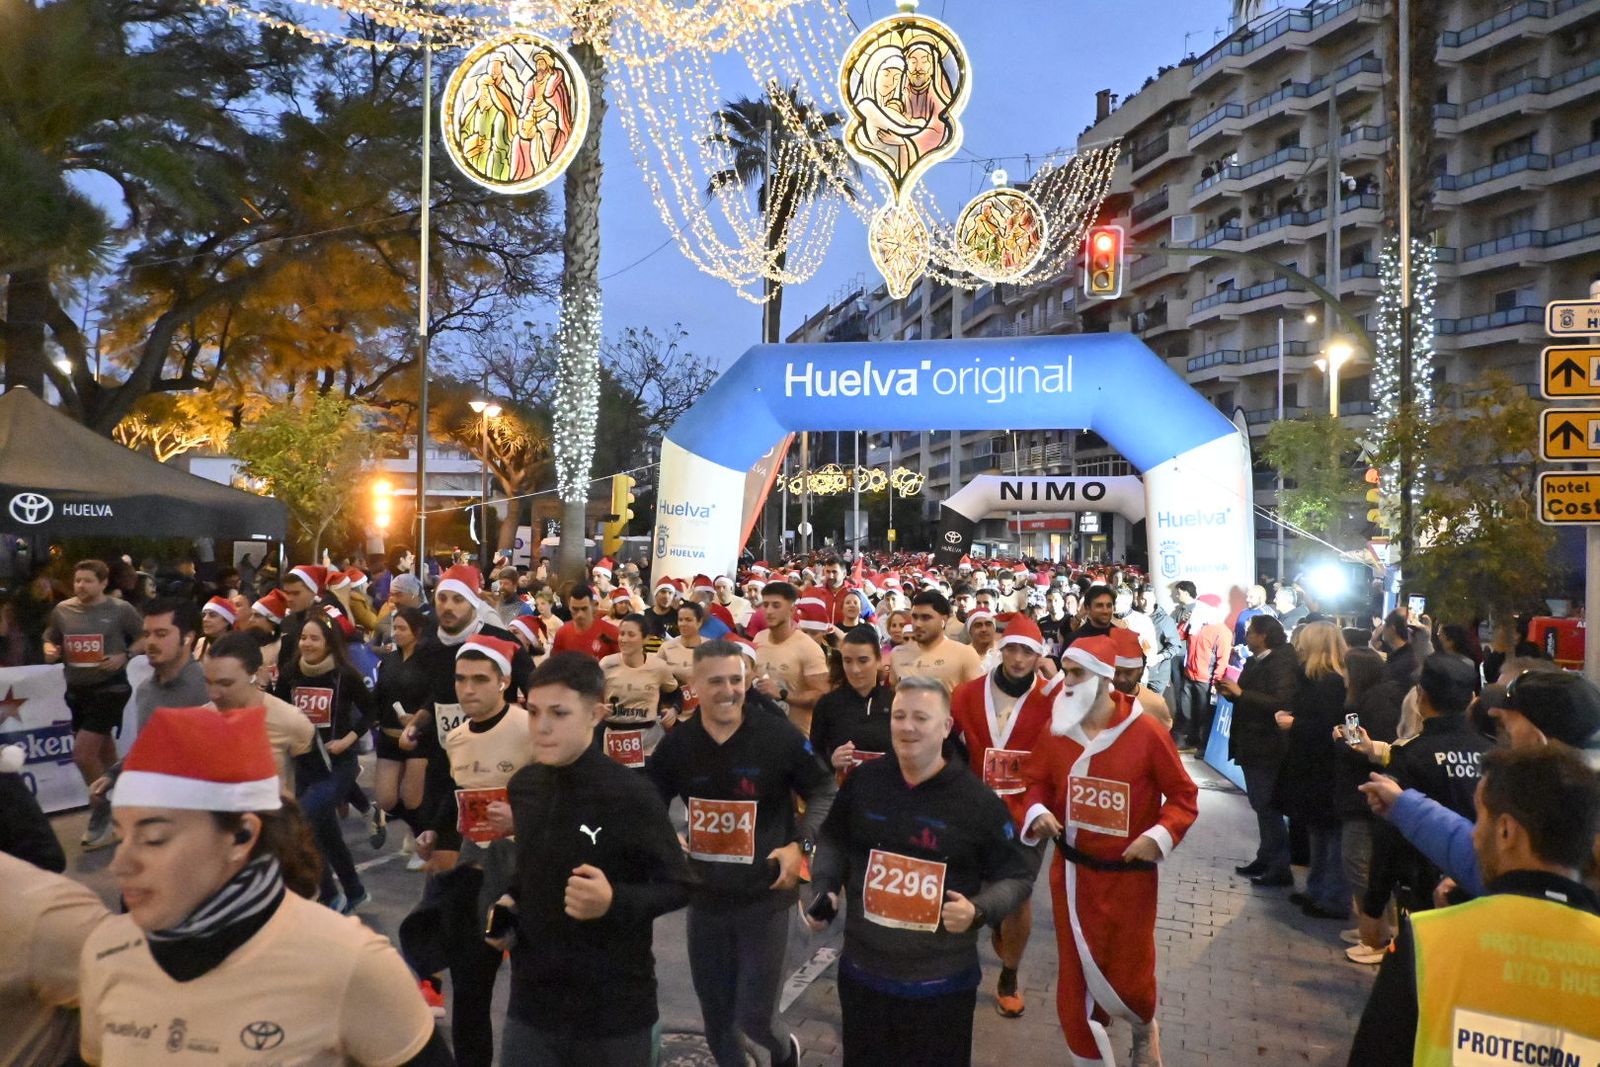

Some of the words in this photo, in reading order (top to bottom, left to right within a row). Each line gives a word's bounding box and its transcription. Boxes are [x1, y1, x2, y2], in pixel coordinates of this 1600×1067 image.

[785, 361, 918, 397] Huelva
[932, 354, 1073, 404] original
[1000, 481, 1106, 502] NIMO
[1546, 480, 1591, 494] hotel
[62, 503, 114, 517] HUELVA
[658, 499, 711, 518] Huelva
[1547, 498, 1600, 516] Cost
[1157, 508, 1227, 529] Huelva
[669, 548, 706, 559] HUELVA
[66, 640, 101, 653] 1959
[294, 694, 329, 711] 1510
[608, 737, 641, 752] 1368
[1434, 750, 1483, 766] POLIC
[1071, 784, 1126, 812] 2269
[692, 809, 752, 834] 2294
[868, 863, 939, 901] 2296
